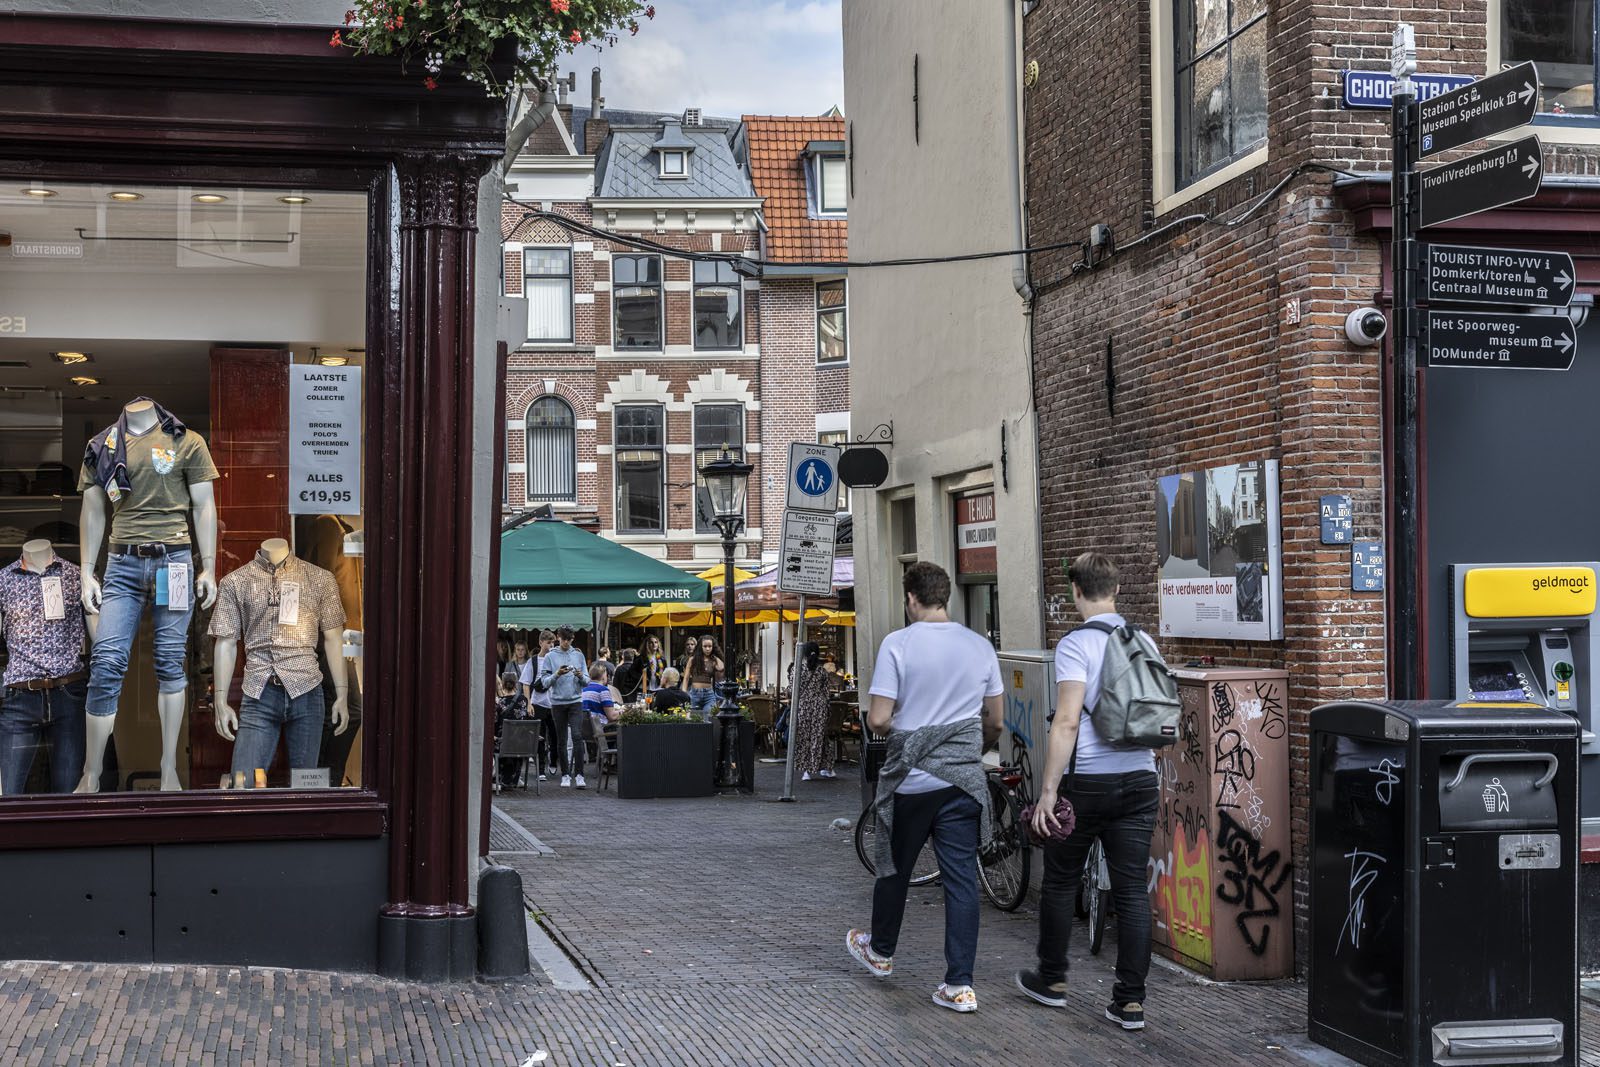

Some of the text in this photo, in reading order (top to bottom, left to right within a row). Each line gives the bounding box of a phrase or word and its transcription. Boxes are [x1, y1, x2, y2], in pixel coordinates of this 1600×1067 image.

[1422, 93, 1469, 119] Station CS
[1422, 96, 1504, 134] Museum Speelklok
[1423, 155, 1505, 189] TivoliVredenburg
[1432, 252, 1483, 265] TOURIST
[1485, 255, 1542, 269] INFO-VVV
[1432, 266, 1521, 282] Domkerk/toren
[1432, 281, 1534, 297] Centraal Museum
[1432, 319, 1520, 334] Het Spoorweg-
[1489, 337, 1538, 347] museum
[1432, 348, 1495, 360] DOMunder
[304, 374, 348, 382] LAATSTE
[806, 448, 827, 456] ZONE
[306, 474, 344, 483] ALLES
[299, 490, 352, 505] €19,95
[967, 495, 993, 521] TE HUUR
[1323, 505, 1330, 517] A
[795, 514, 829, 523] Toegestaan
[1355, 553, 1362, 564] A
[1162, 580, 1233, 595] Het verdwenen koor
[1532, 575, 1589, 591] geldmaat
[637, 588, 690, 599] GULPENER
